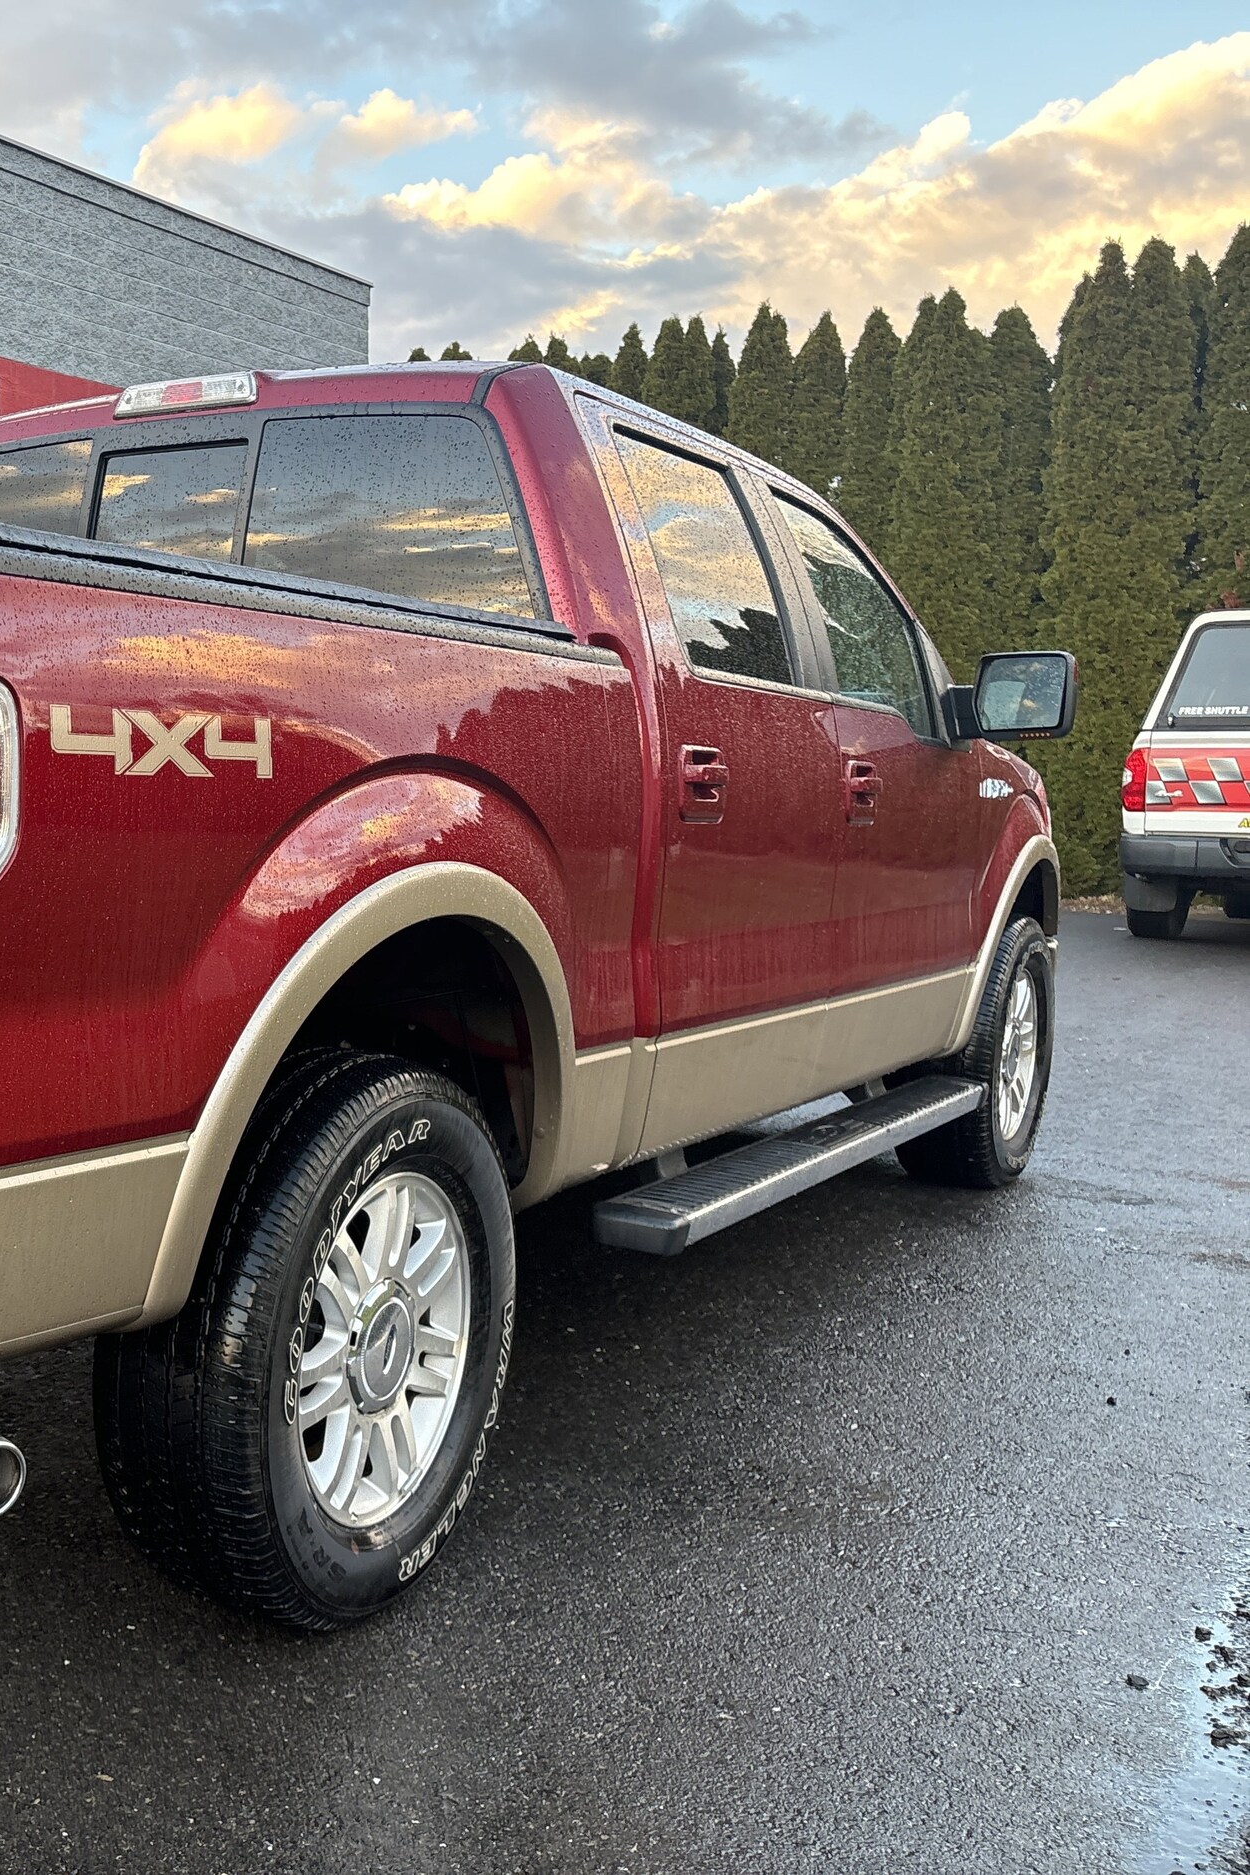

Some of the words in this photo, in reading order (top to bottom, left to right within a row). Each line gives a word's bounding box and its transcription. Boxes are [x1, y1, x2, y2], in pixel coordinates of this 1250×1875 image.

[1178, 706, 1203, 716] FREE
[1204, 706, 1248, 715] SHUTTLE
[284, 1118, 431, 1426] GOODYEAR
[399, 1299, 515, 1582] WRANGLER
